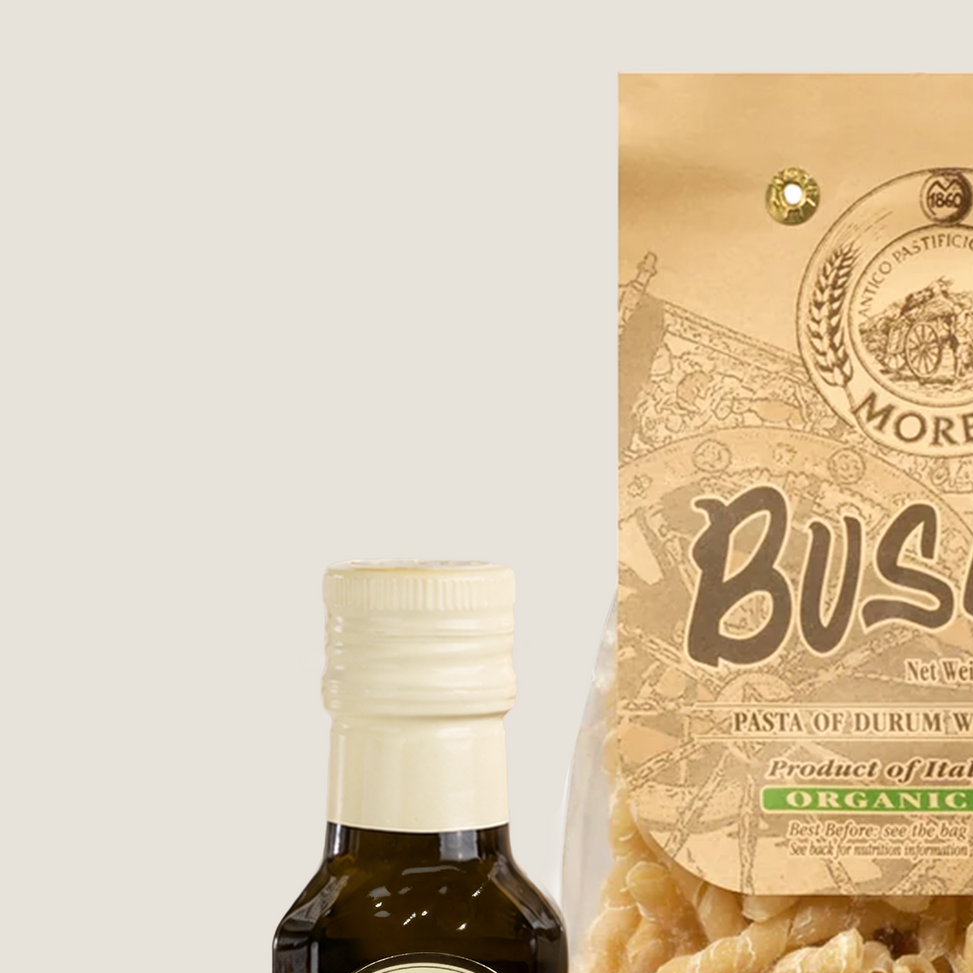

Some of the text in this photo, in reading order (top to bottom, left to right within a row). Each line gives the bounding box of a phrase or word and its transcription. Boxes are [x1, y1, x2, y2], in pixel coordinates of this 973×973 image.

[930, 192, 963, 209] 1860
[859, 260, 893, 316] ANTICO
[906, 660, 936, 681] Net
[733, 712, 803, 732] PASTA
[813, 712, 844, 732] OF
[854, 712, 942, 733] DURUM
[768, 759, 879, 778] Product
[887, 759, 921, 783] of
[786, 791, 968, 809] ORGANIC
[789, 821, 967, 841] Best Before: see the bag
[790, 842, 807, 856] See
[809, 842, 833, 856] back
[833, 842, 851, 860] for
[854, 843, 901, 856] nutrition
